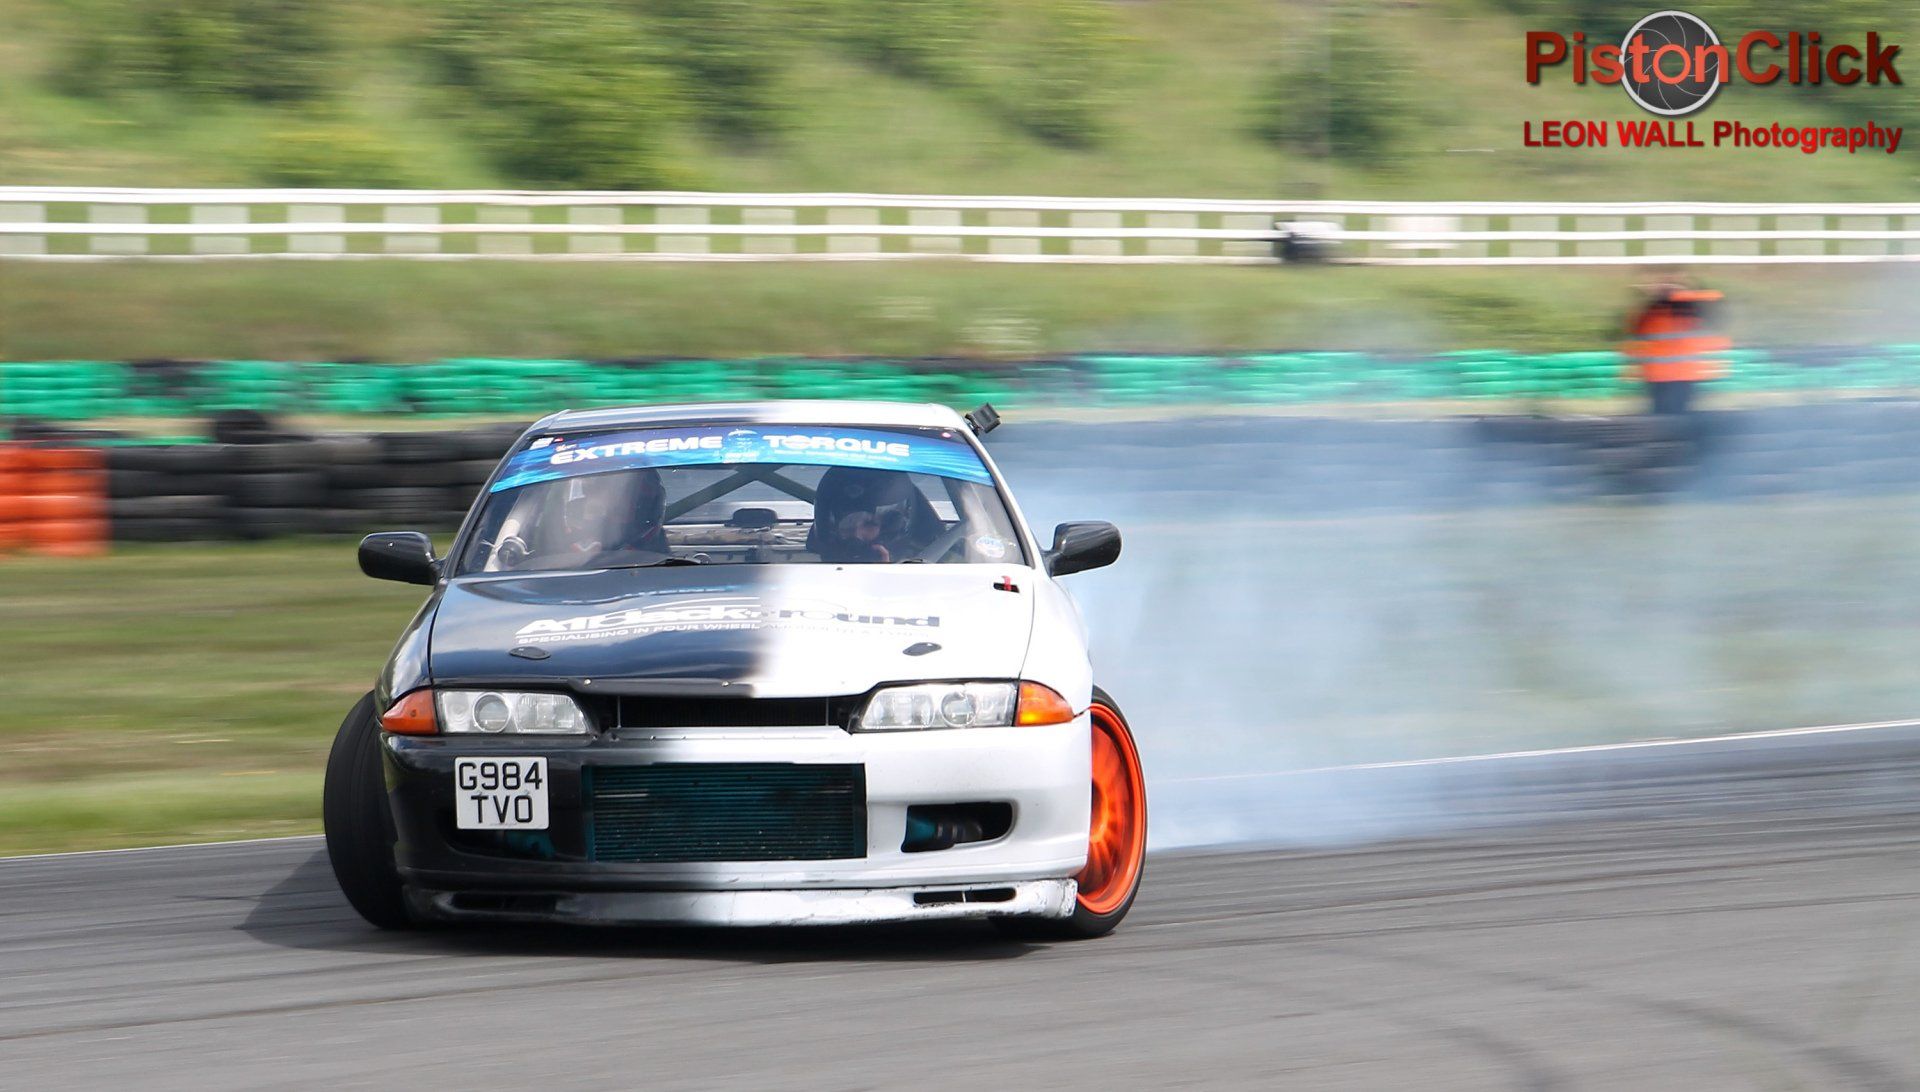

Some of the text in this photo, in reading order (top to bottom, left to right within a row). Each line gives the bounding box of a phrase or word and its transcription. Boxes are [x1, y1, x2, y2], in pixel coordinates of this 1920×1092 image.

[551, 436, 723, 465] EXTREME
[763, 434, 910, 457] TORQUE
[518, 629, 628, 644] SPECIALISING
[633, 626, 649, 635] IN
[652, 624, 700, 634] FOUR
[703, 623, 760, 631] WHEEL
[459, 762, 543, 790] G984
[471, 795, 533, 823] TVO
